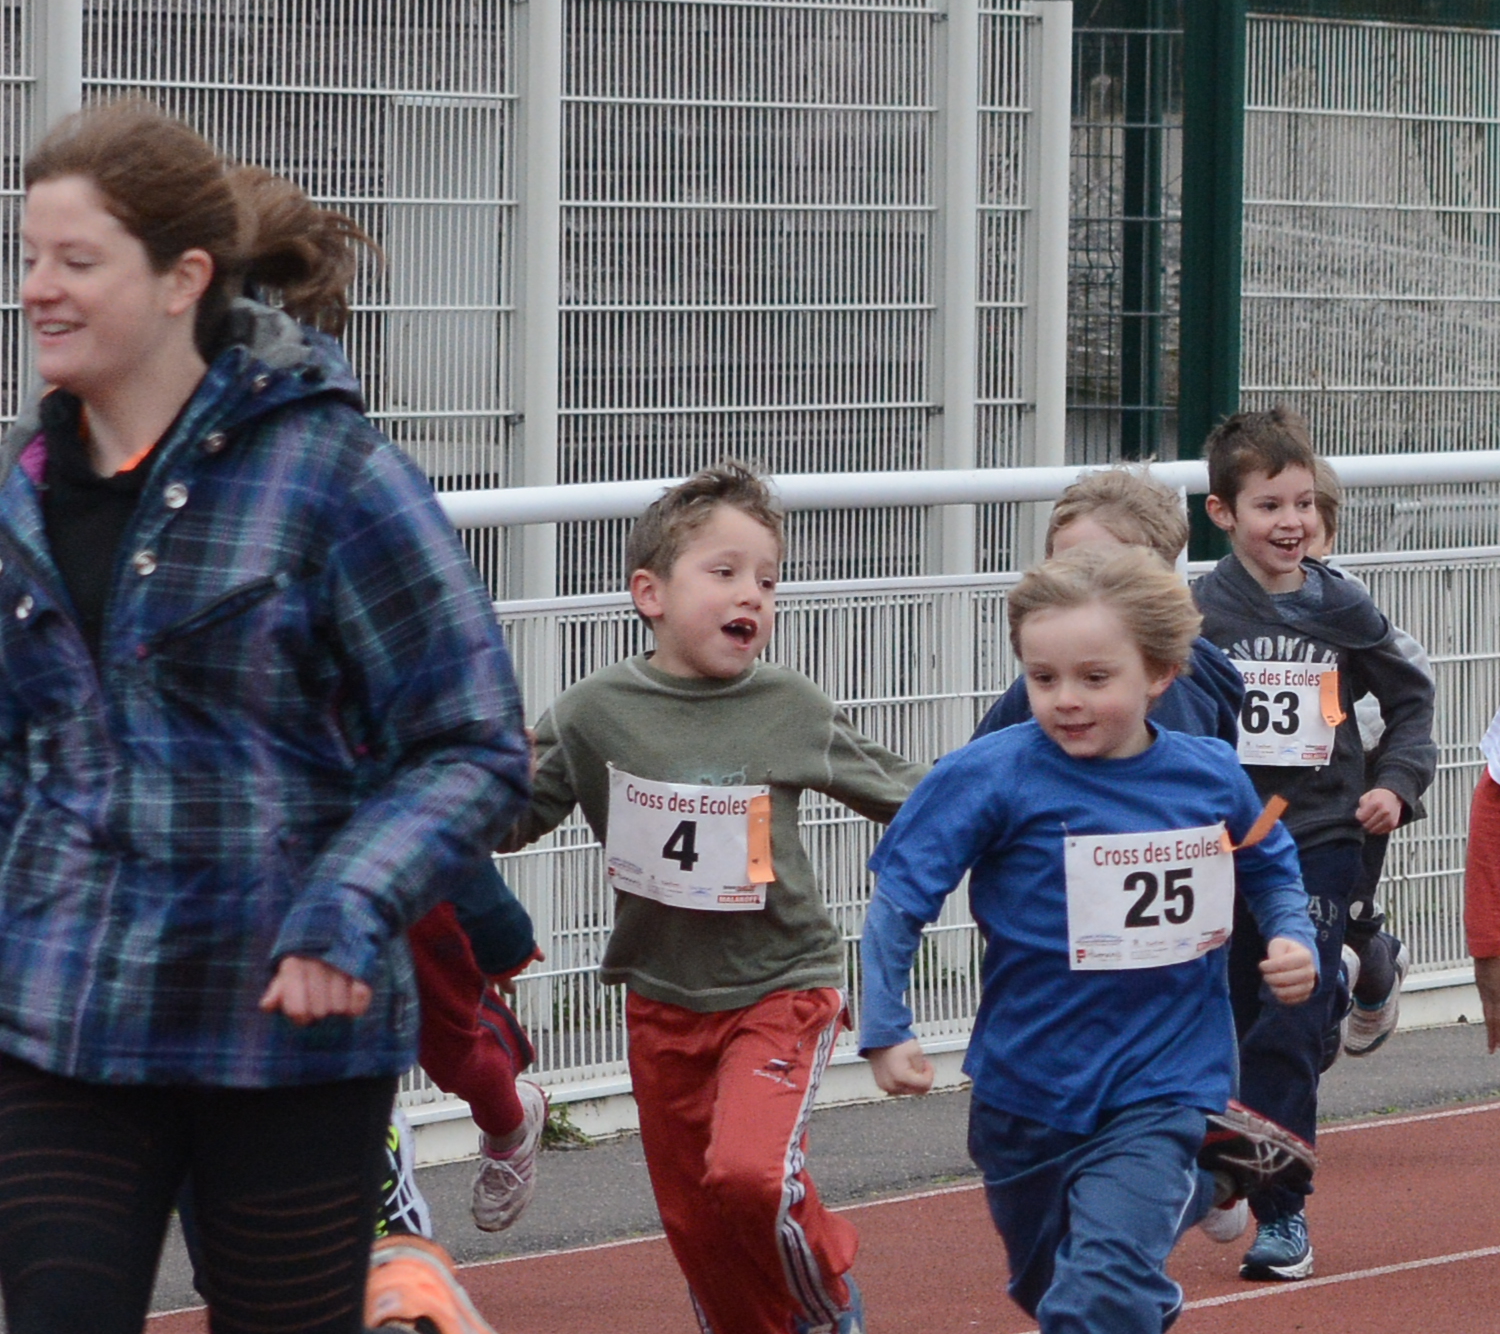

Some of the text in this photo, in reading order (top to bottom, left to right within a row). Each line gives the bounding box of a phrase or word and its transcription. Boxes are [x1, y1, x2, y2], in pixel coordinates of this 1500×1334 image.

[1258, 668, 1281, 686] des
[1284, 670, 1320, 686] Ecoles
[1241, 690, 1299, 735] 63
[626, 784, 747, 815] Cross des Ecoles
[662, 820, 699, 872] 4
[1094, 837, 1219, 866] Cross des Ecoles
[1123, 867, 1194, 928] 25
